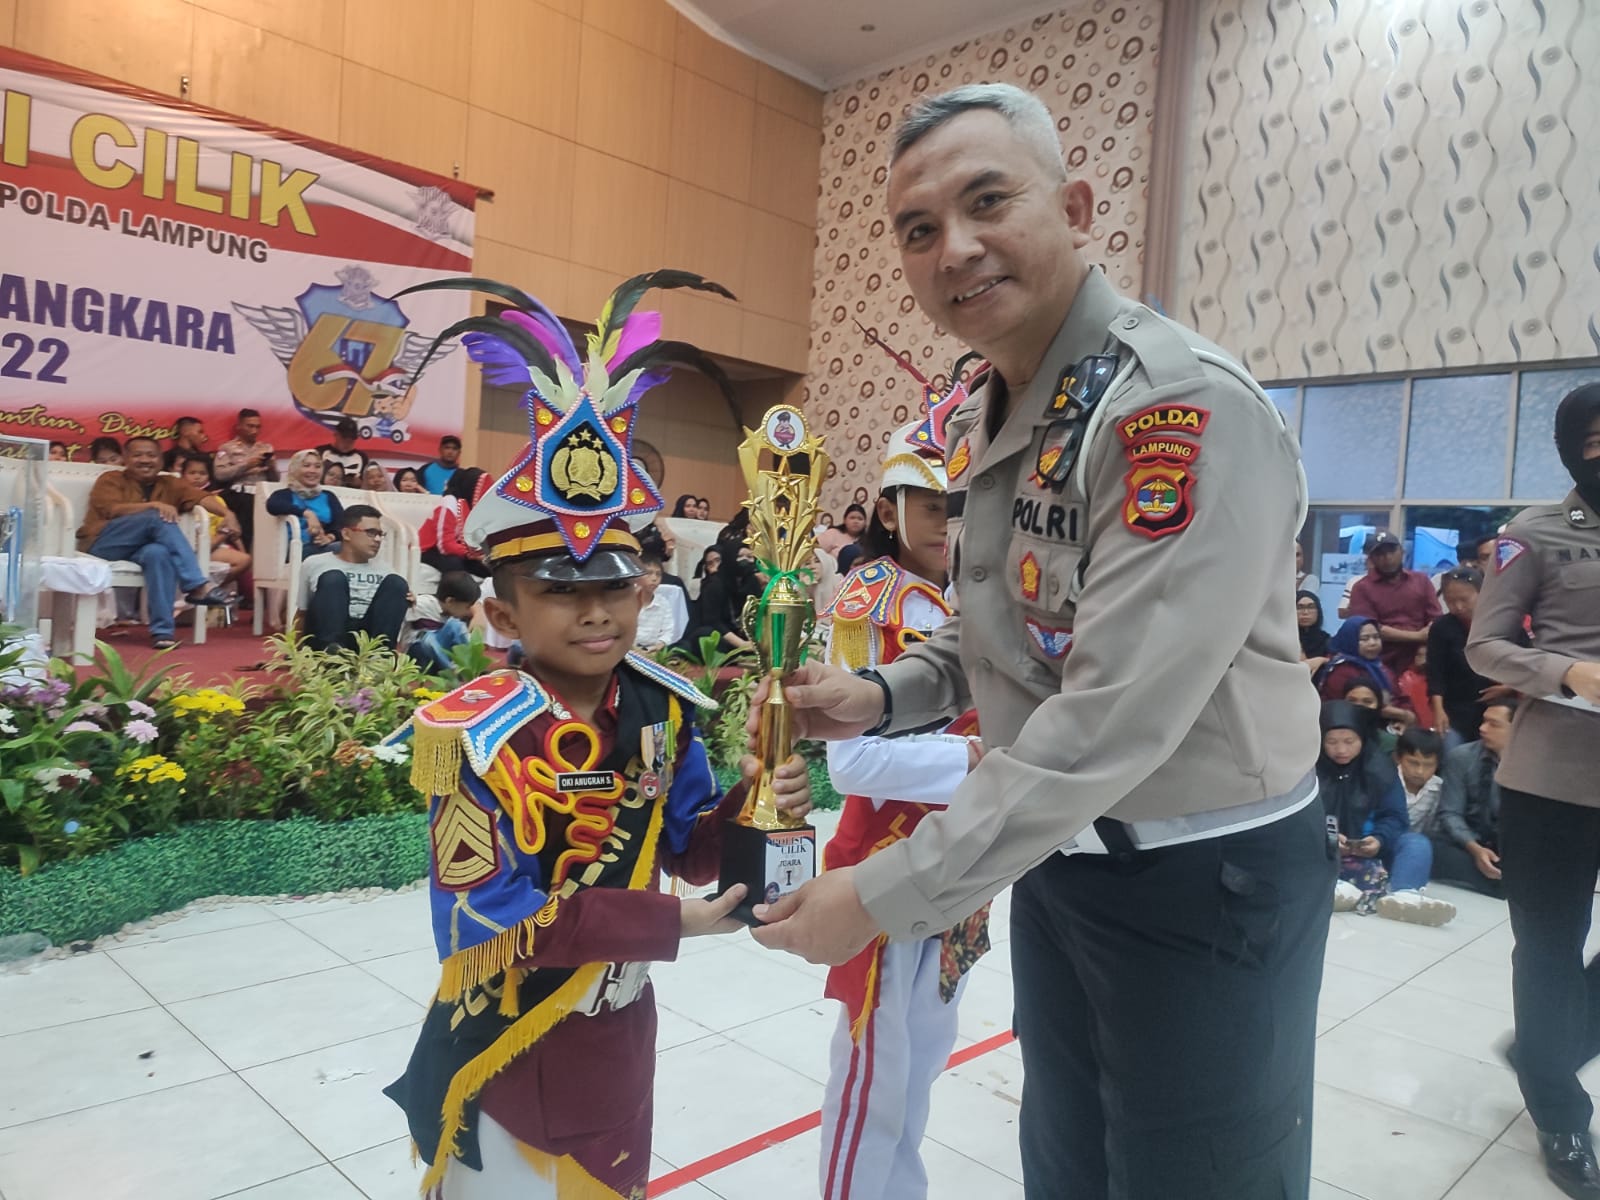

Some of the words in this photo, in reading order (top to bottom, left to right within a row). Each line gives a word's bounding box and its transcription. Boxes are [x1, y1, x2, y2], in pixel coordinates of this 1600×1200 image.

[69, 112, 321, 237] CILIK
[0, 182, 111, 231] POLDA
[121, 210, 269, 264] LAMPUNG
[0, 273, 236, 355] ANGKARA
[0, 332, 70, 384] 22
[1124, 408, 1200, 438] POLDA
[1132, 442, 1192, 458] LAMPUNG
[1012, 497, 1078, 541] POLRI
[574, 776, 605, 786] ANUGRAH
[779, 858, 801, 867] JUARA
[781, 845, 806, 854] CILIK
